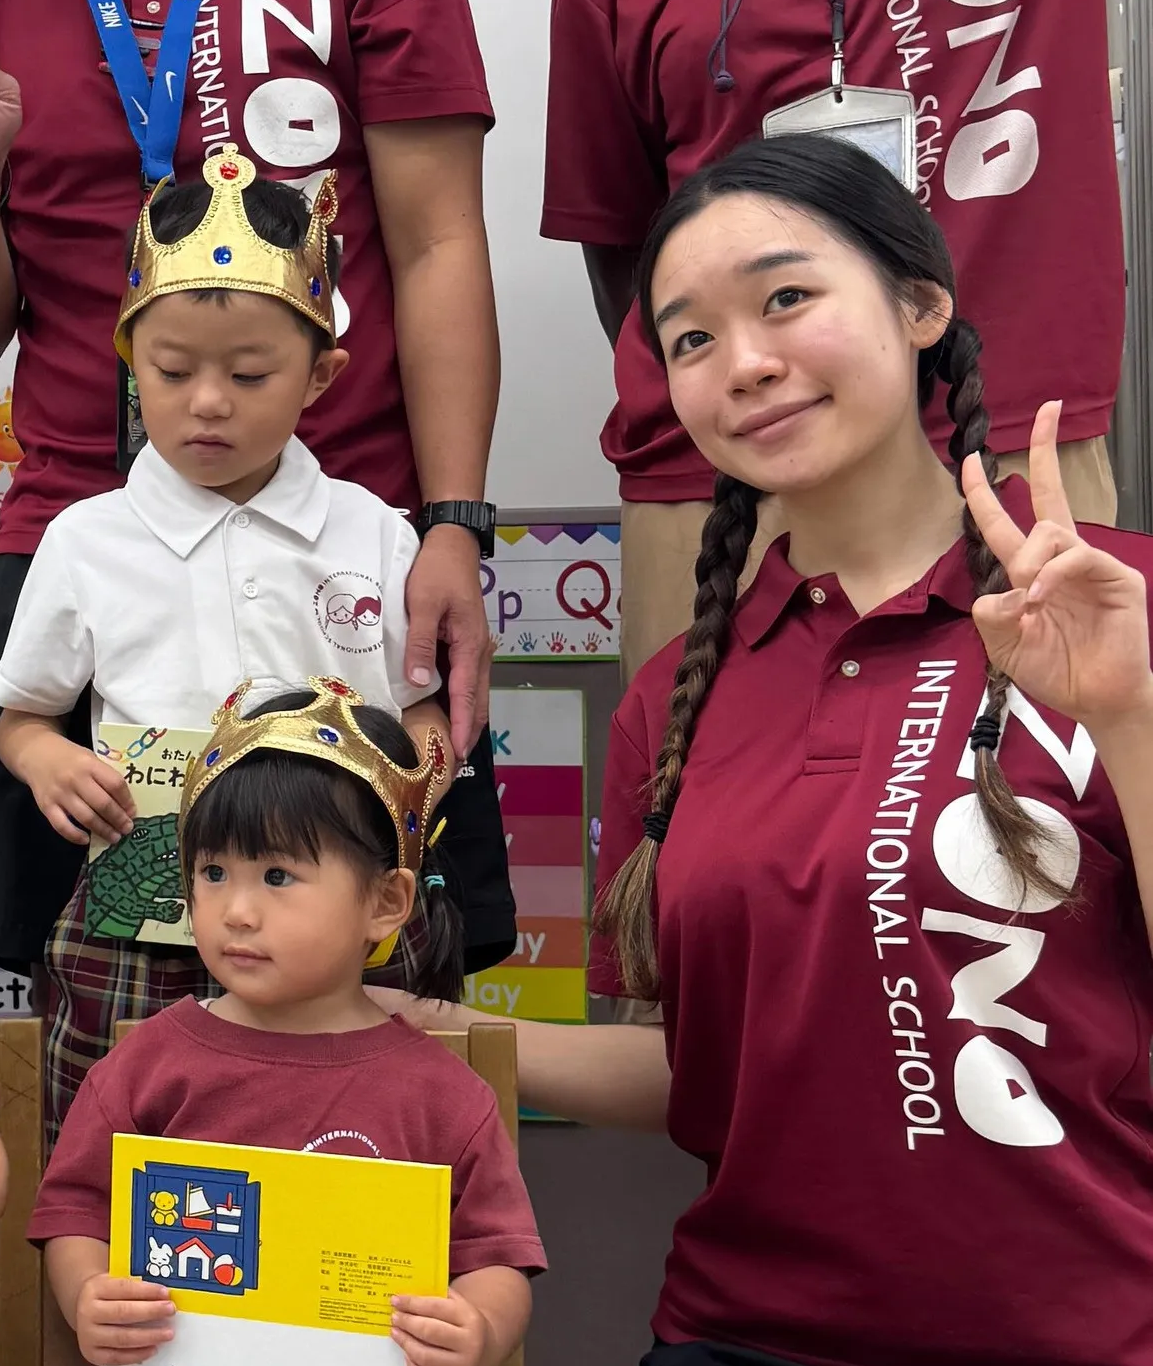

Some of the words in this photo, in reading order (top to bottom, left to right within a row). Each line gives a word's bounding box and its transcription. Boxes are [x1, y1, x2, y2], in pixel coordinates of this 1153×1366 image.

[98, 1, 123, 28] NIKE
[865, 660, 959, 961] INTERNATIONAL
[882, 975, 945, 1151] SCHOOL
